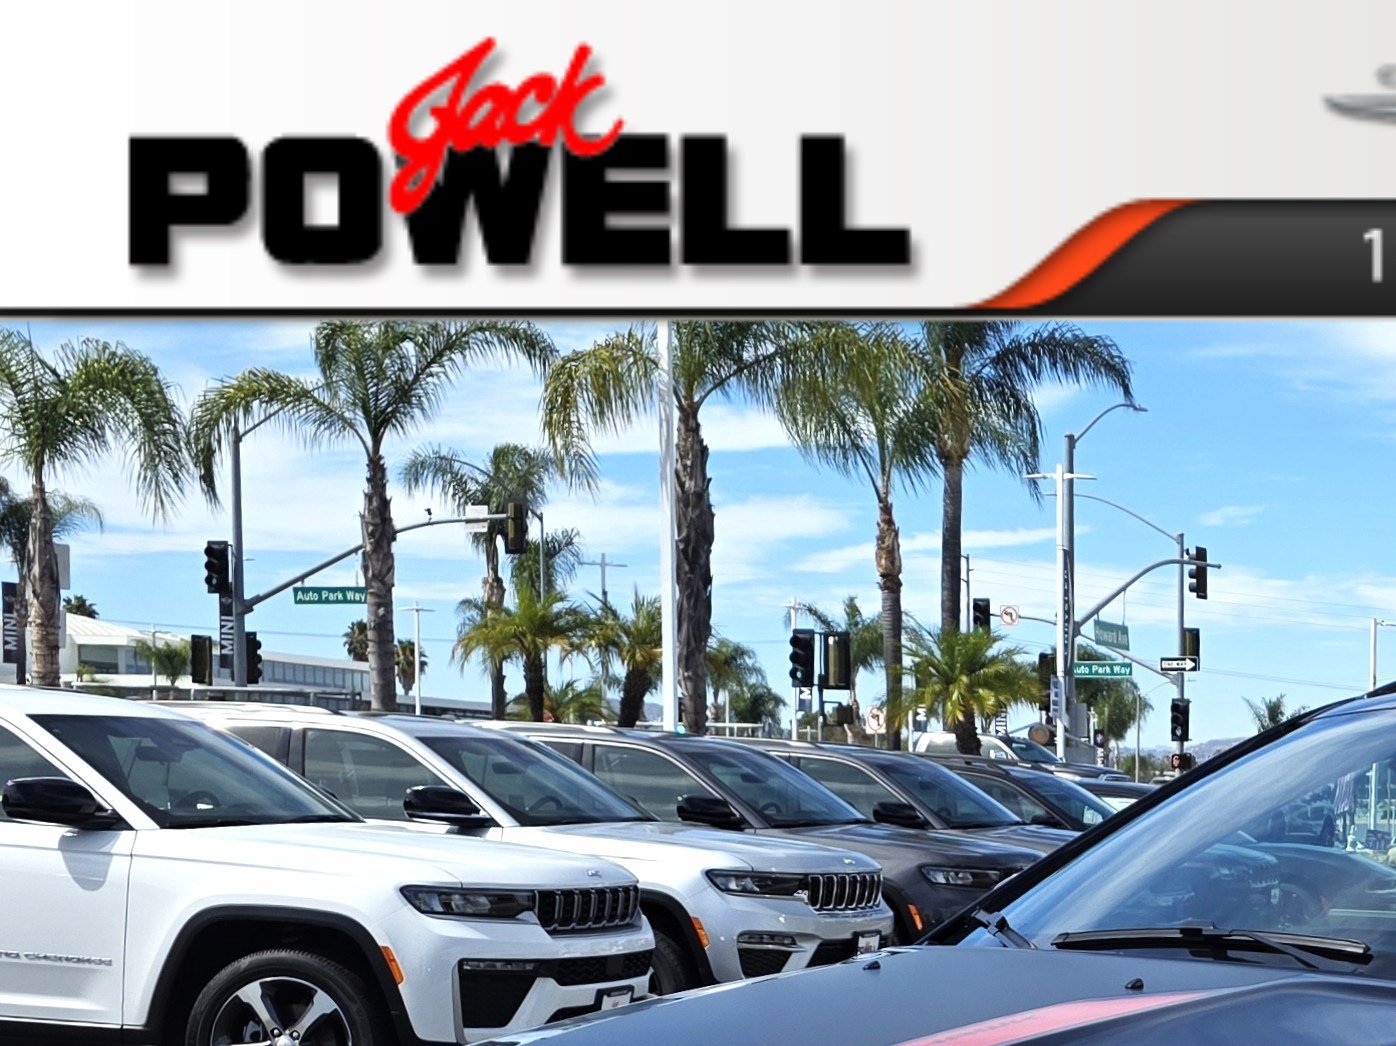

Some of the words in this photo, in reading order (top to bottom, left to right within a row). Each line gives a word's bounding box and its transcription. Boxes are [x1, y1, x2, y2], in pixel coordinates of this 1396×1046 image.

[296, 590, 318, 601] Auto
[321, 590, 343, 601] Park
[346, 591, 365, 603] Way
[221, 615, 235, 655] MINI
[1092, 664, 1111, 674] Park
[1113, 665, 1131, 677] Way
